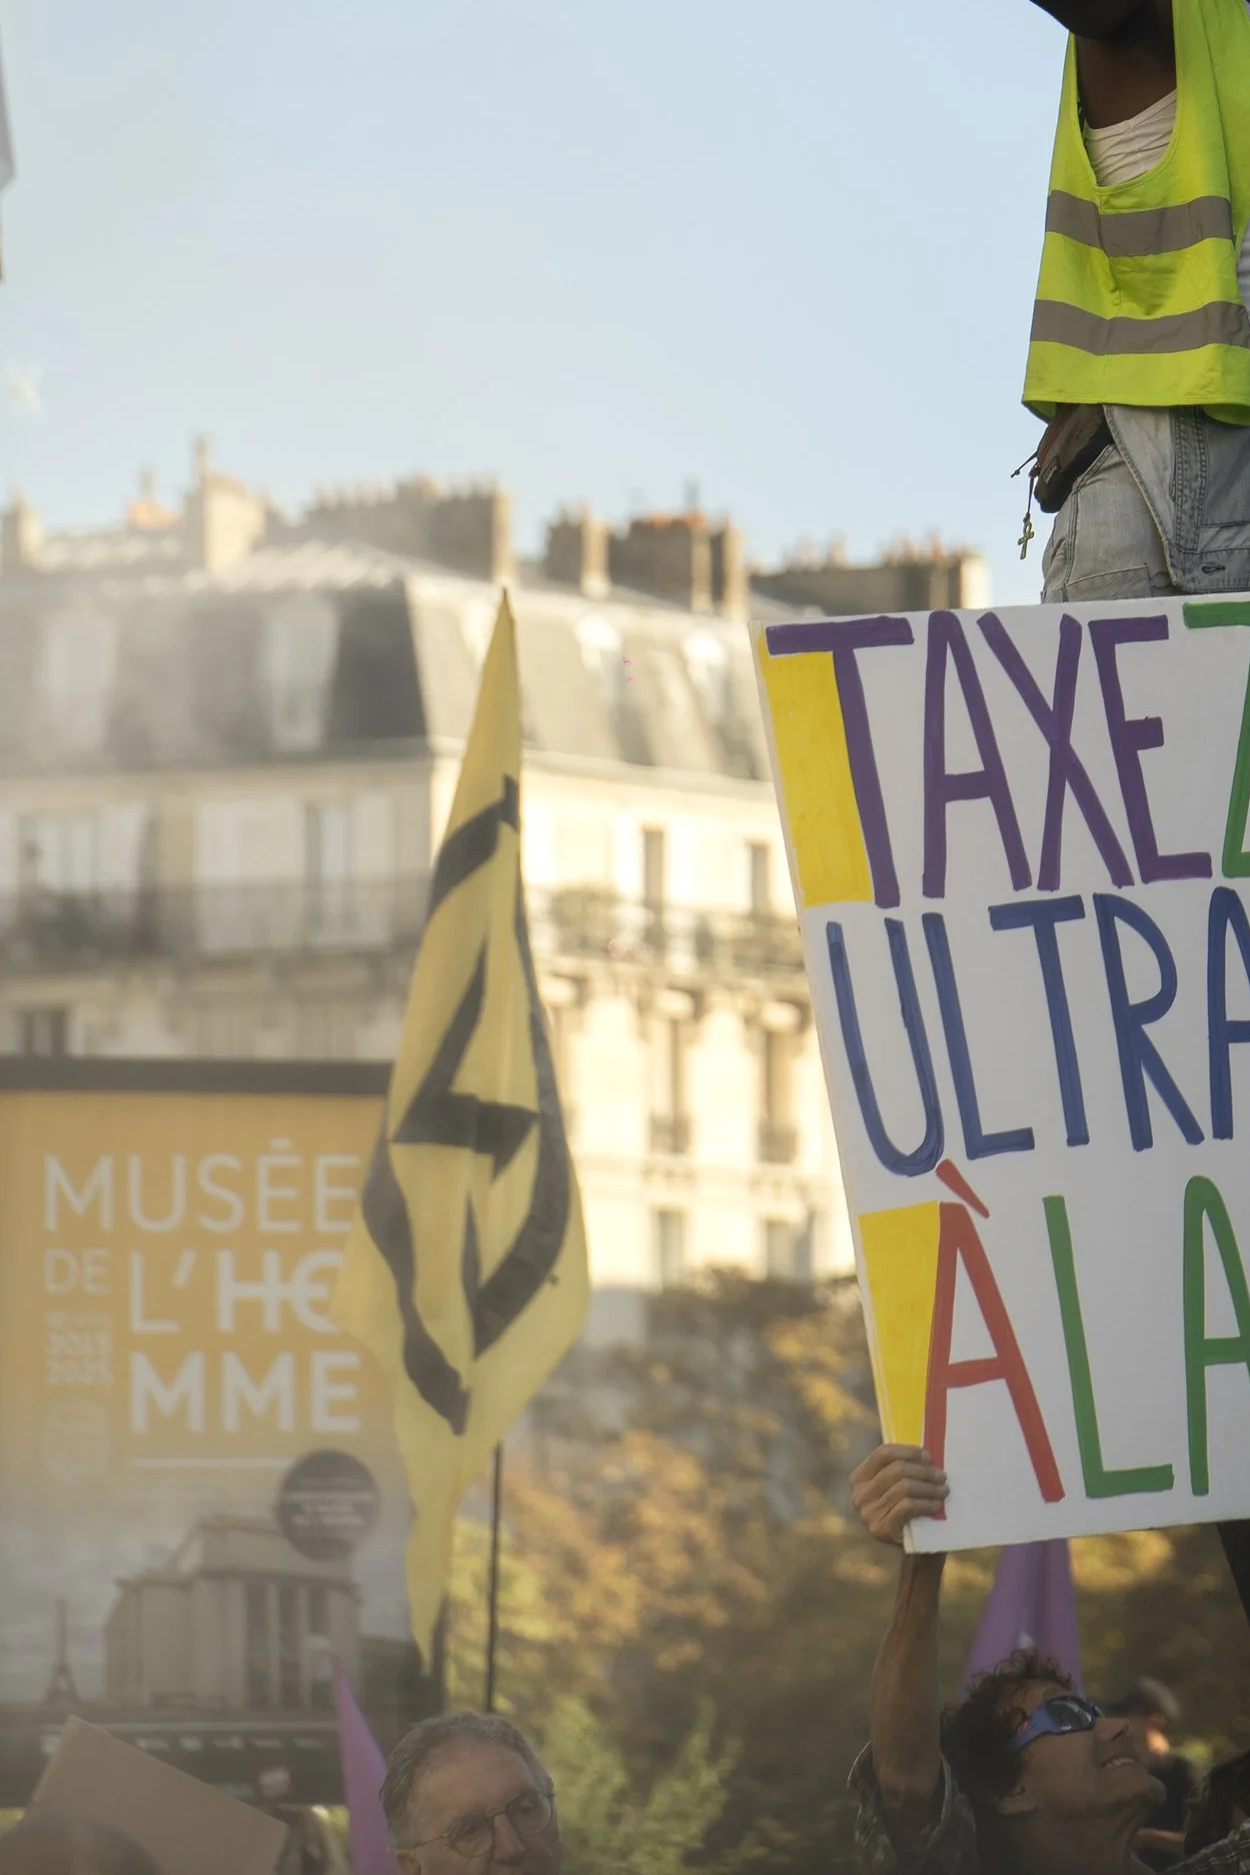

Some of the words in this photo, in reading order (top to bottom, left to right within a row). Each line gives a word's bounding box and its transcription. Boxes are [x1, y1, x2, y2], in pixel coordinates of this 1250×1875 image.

[767, 609, 1212, 909] TAXE
[44, 1137, 361, 1234] MUSÉE
[44, 1247, 111, 1295] DE
[919, 1159, 1065, 1520] À
[130, 1348, 361, 1435] MME
